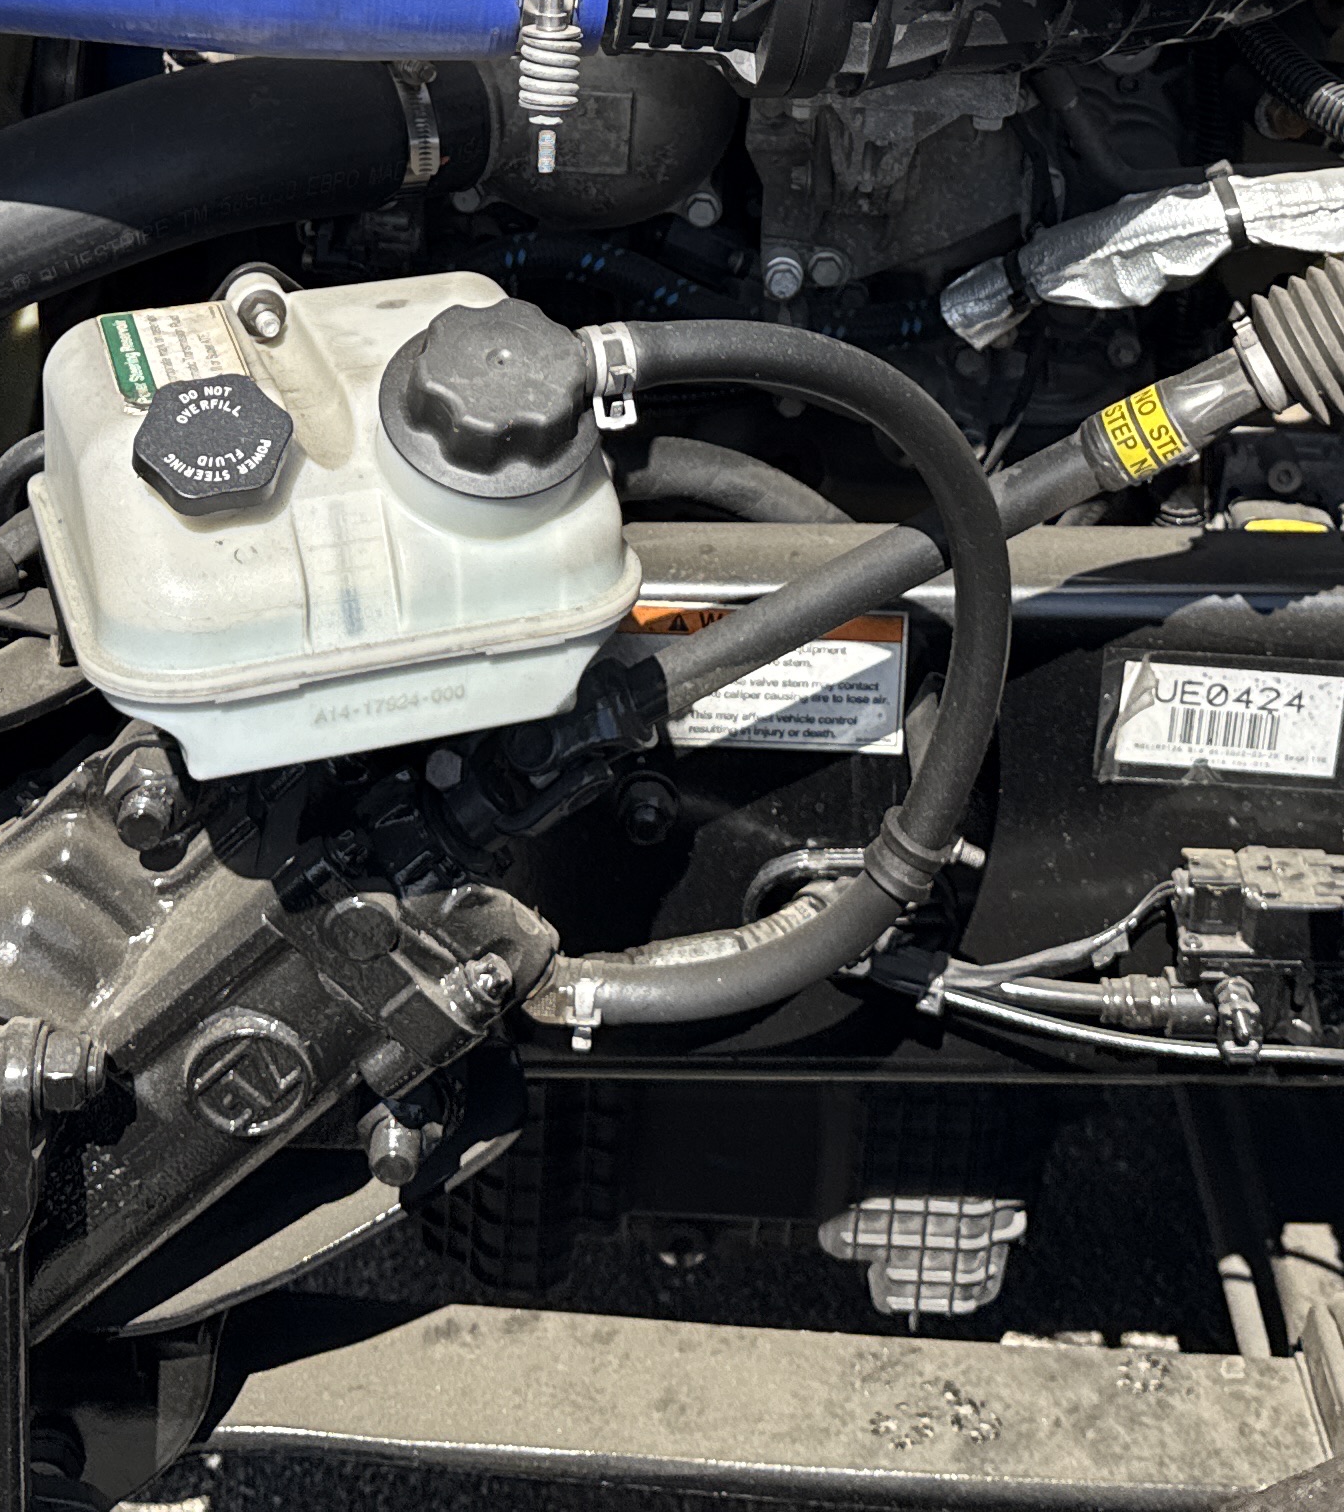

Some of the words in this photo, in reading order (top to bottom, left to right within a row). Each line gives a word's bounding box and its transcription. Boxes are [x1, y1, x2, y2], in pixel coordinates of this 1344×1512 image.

[178, 389, 199, 404] DO
[204, 386, 233, 398] NOT
[1134, 389, 1156, 416] NO
[176, 398, 242, 424] OVERFILL
[1104, 404, 1136, 450] STEP
[197, 448, 245, 467] FLUID
[236, 438, 272, 475] POWER
[163, 453, 231, 482] STEERING
[795, 644, 847, 657] quipment
[749, 677, 779, 688] valve
[781, 678, 808, 688] stem
[811, 681, 834, 692] may
[838, 681, 879, 692] contact
[724, 689, 761, 701] caliper
[764, 692, 808, 704] causing
[831, 694, 843, 703] to
[846, 694, 870, 704] lose
[872, 694, 890, 705] air.
[1154, 679, 1305, 714] UE0424
[691, 710, 713, 721] This
[715, 712, 738, 723] may
[742, 712, 774, 723] affect
[776, 713, 815, 724] vehicle
[818, 714, 858, 725] control
[689, 726, 738, 737] resulting
[741, 726, 751, 736] in
[753, 727, 785, 739] injury
[788, 729, 800, 738] or
[802, 727, 836, 738] death.
